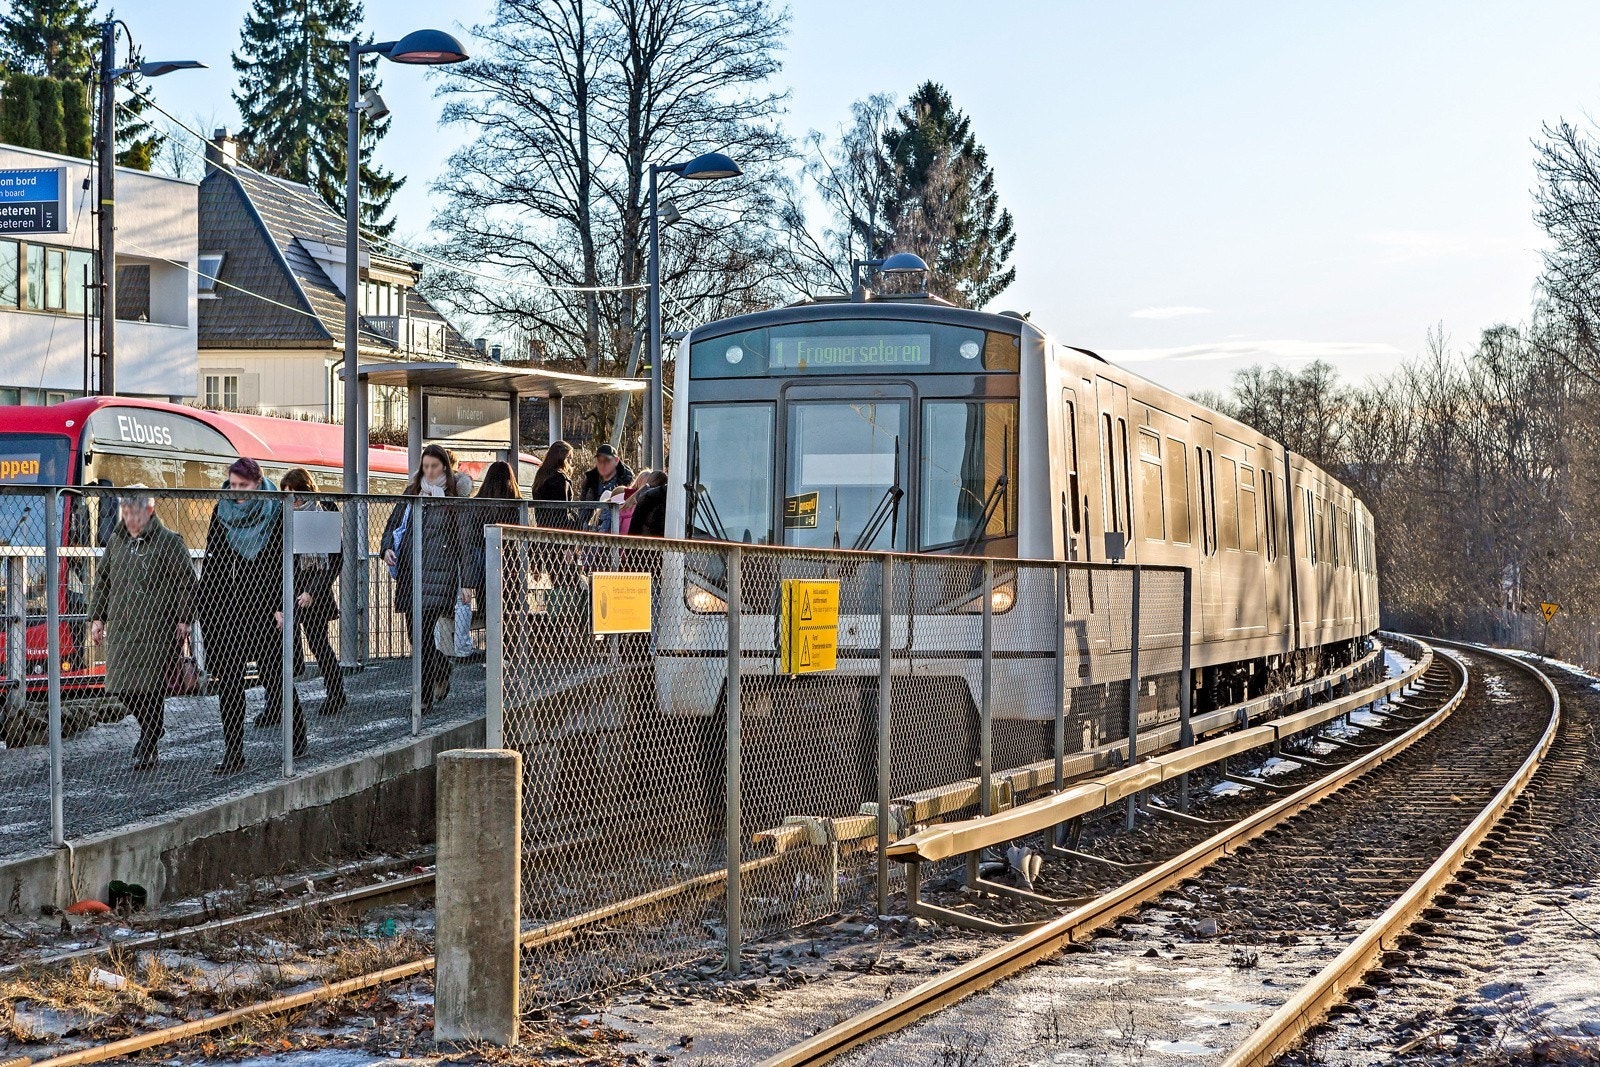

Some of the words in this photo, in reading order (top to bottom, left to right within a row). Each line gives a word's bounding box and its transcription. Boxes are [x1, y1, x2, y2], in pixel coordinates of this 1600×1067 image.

[16, 176, 37, 186] bord
[46, 220, 51, 228] 2
[775, 341, 783, 365] 1
[797, 339, 921, 364] Frognerseteren
[117, 415, 172, 446] Elbuss
[1546, 606, 1552, 616] 4
